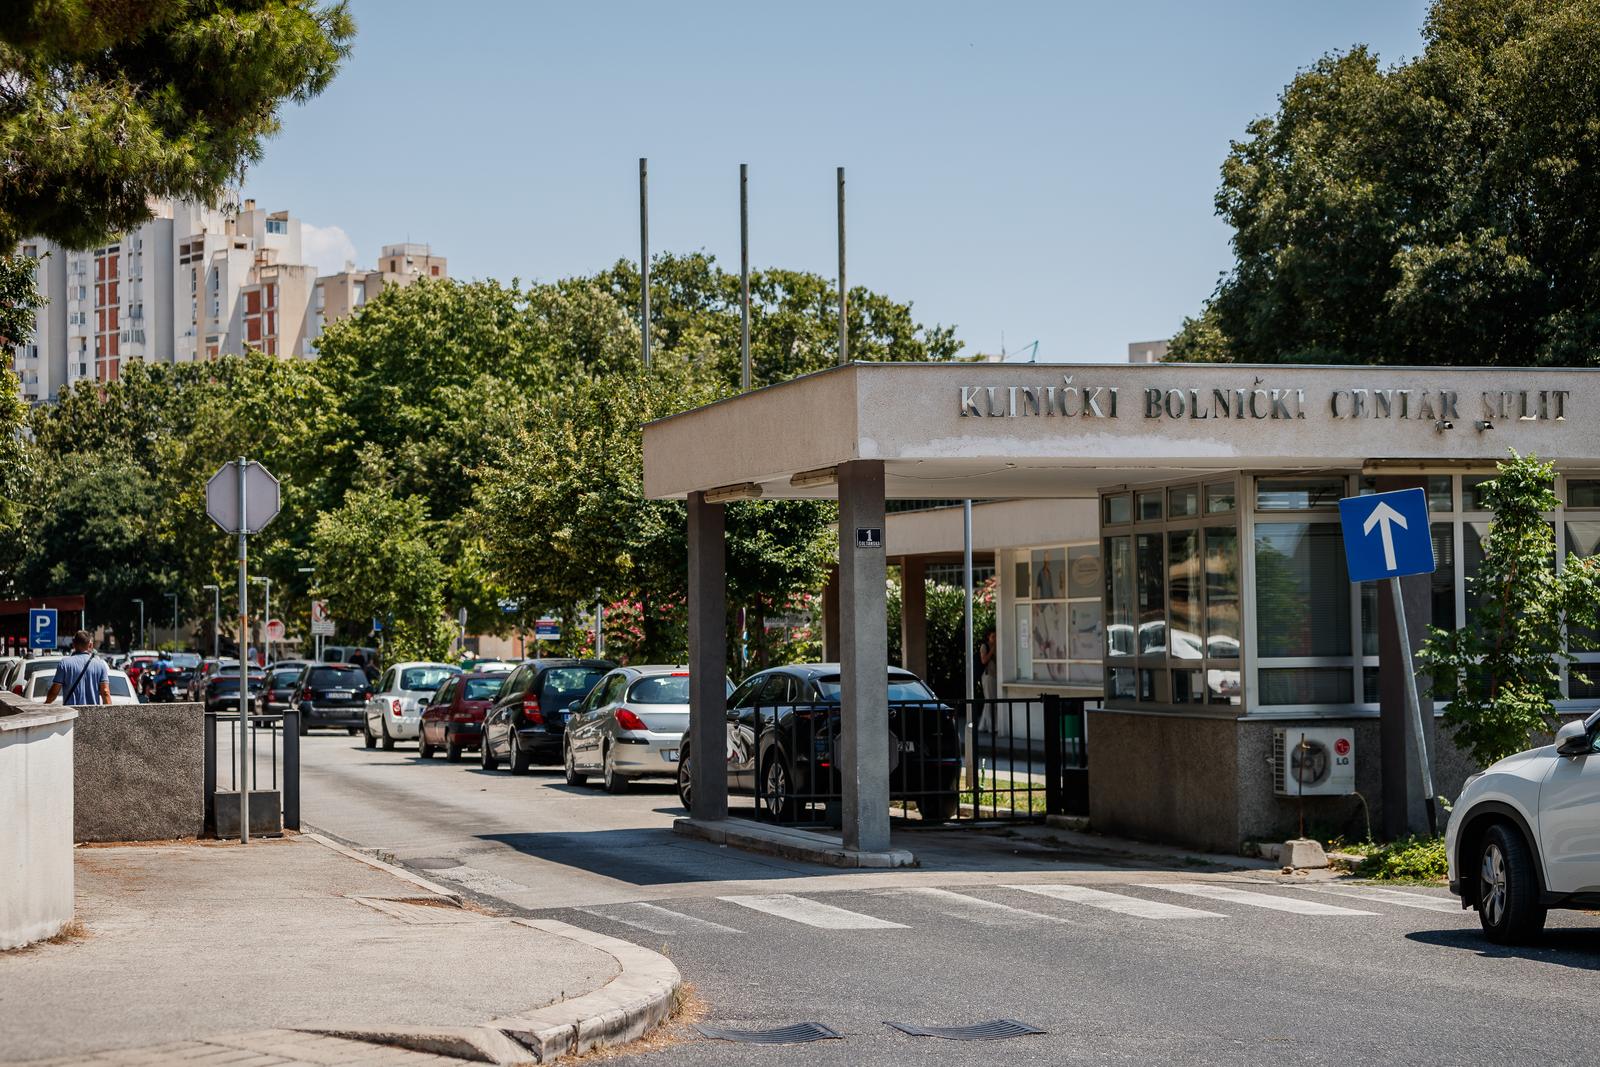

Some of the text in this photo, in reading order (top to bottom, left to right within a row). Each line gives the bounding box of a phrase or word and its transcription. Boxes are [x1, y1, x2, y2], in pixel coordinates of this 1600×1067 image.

[959, 375, 1570, 421] KLINIČKI BOLNIČKI CENTAR SPLIT
[866, 529, 873, 542] 1
[36, 615, 51, 633] P
[1336, 757, 1349, 766] LG
